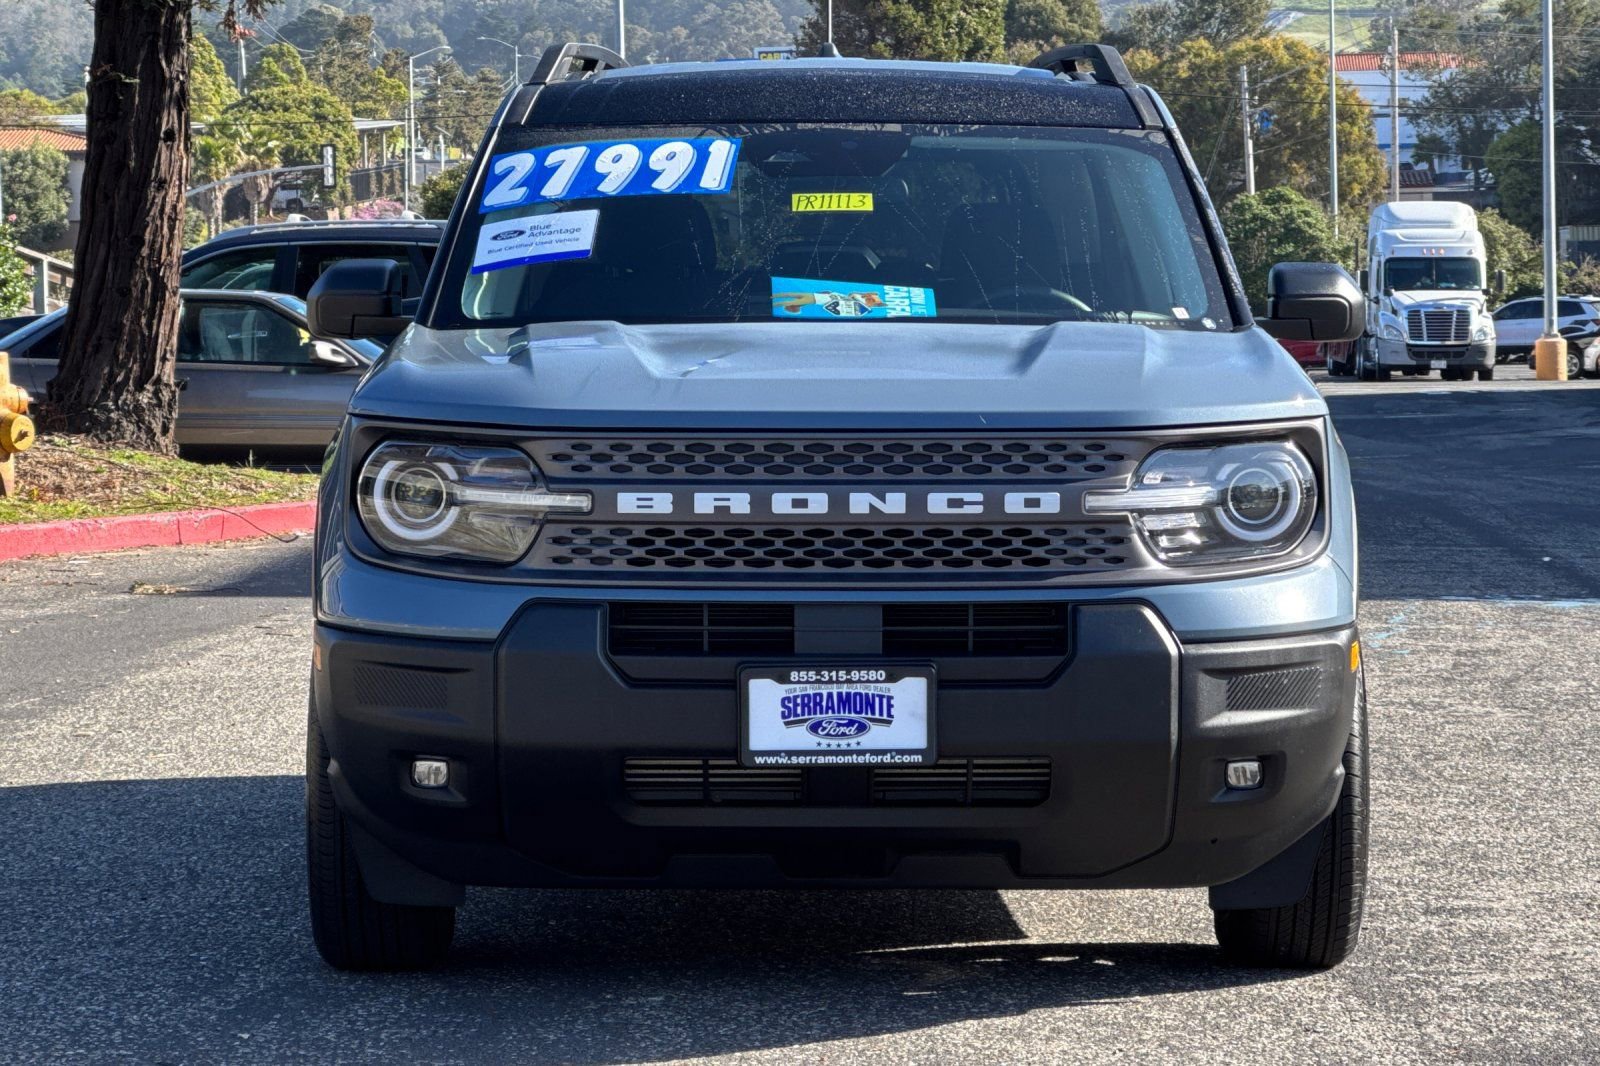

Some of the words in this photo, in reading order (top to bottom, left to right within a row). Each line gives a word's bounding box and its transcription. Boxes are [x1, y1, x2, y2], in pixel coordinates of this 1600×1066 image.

[483, 139, 736, 207] 27991
[796, 194, 868, 210] PR11113
[528, 227, 581, 238] Advantage
[530, 223, 552, 232] Blue
[504, 242, 534, 251] Certified
[617, 492, 1061, 514] BRONCO
[790, 670, 886, 682] 855-315-9580
[780, 691, 895, 720] SERRAMONTE
[818, 719, 858, 735] Ford
[754, 752, 923, 764] www.serramonteford.com
